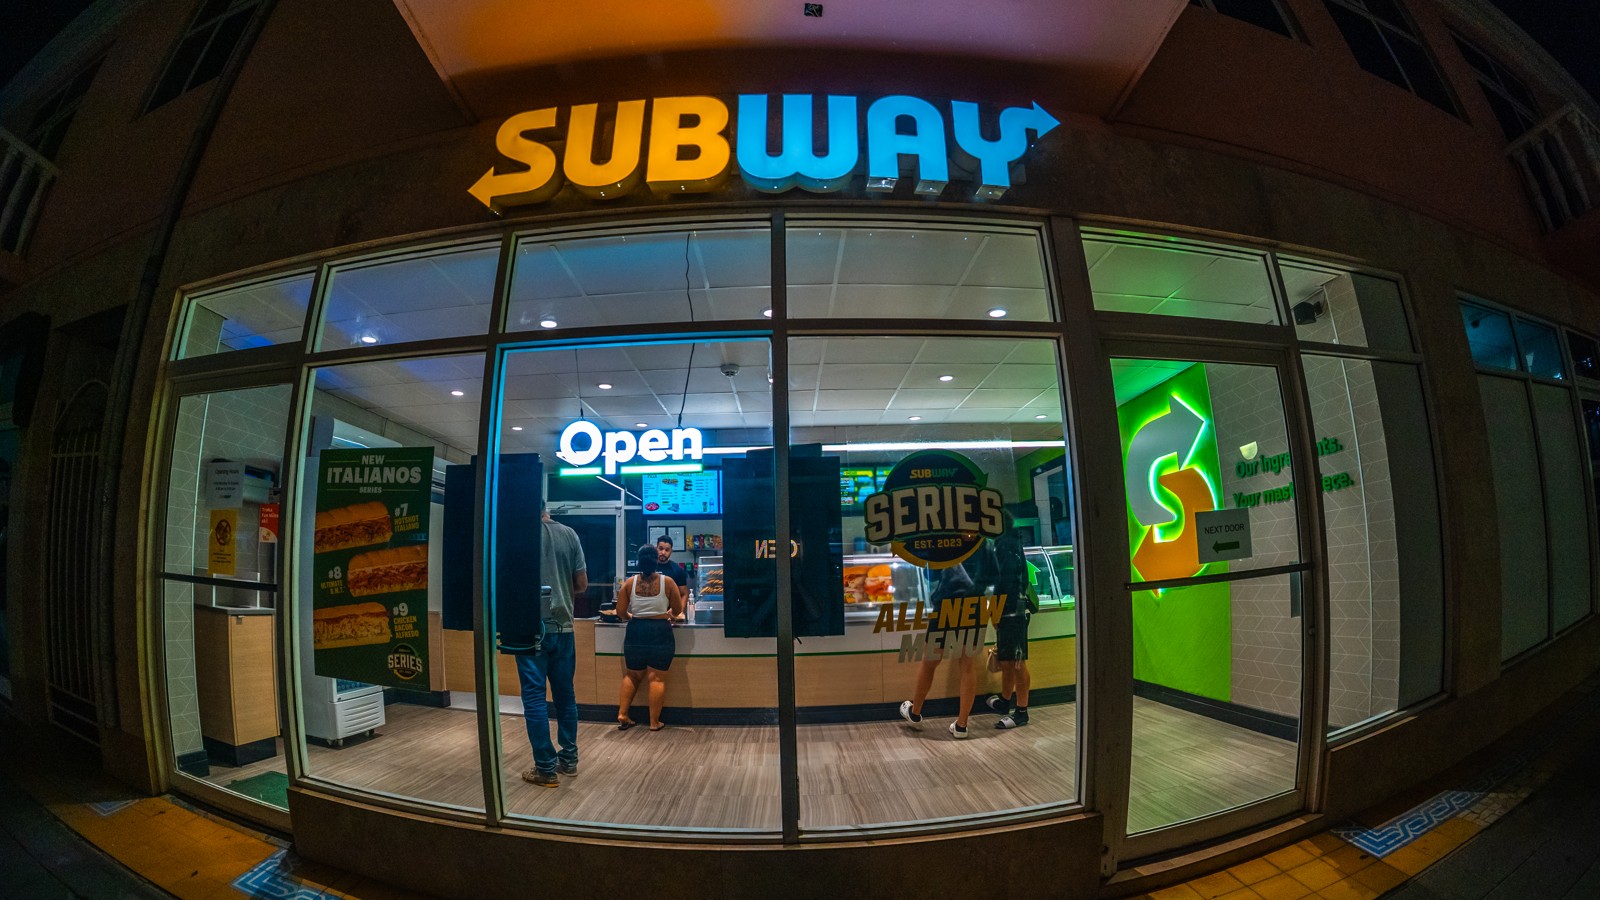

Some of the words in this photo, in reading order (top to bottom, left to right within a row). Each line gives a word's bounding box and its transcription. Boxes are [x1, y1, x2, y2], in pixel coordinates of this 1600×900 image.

[467, 94, 1061, 213] SUBWAY
[559, 420, 703, 475] Open
[361, 455, 385, 465] NEW
[326, 466, 422, 484] ITALIANOS
[909, 467, 959, 480] SUBWAY
[1236, 461, 1258, 478] Our
[359, 486, 383, 494] SERIES
[1232, 491, 1262, 509] Your
[394, 503, 409, 517] #7
[866, 484, 1004, 542] SERIES
[1204, 525, 1223, 534] NEXT
[1224, 523, 1245, 533] DOOR
[914, 539, 935, 549] EST.
[937, 538, 962, 548] 2023
[328, 566, 342, 579] #8
[392, 602, 409, 617] #9
[872, 594, 1008, 634] ALL-NEW
[393, 616, 418, 625] CHICKEN
[394, 623, 413, 632] BACON
[395, 630, 420, 639] ALFREDO
[898, 628, 987, 664] MENU
[387, 653, 423, 673] SERIES
